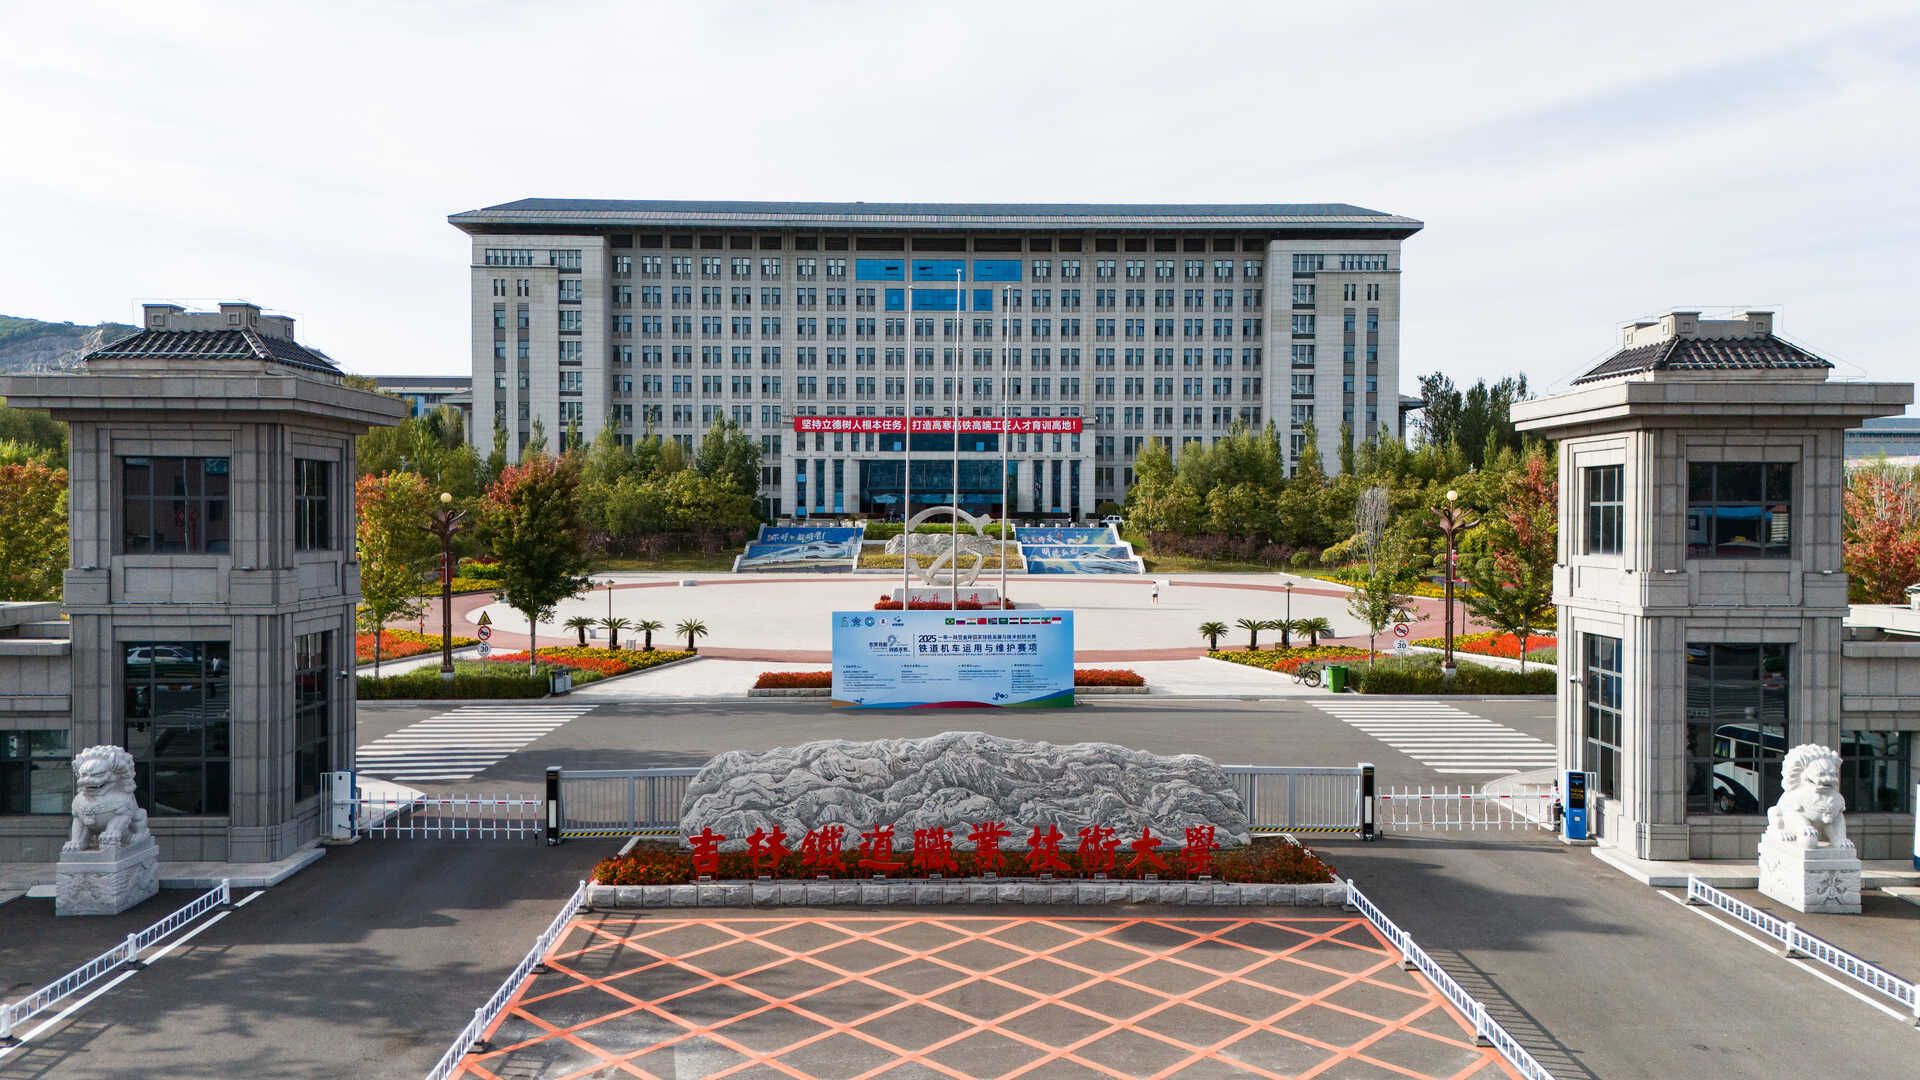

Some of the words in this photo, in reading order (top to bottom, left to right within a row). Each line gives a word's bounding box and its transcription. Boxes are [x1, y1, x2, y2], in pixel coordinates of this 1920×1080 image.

[918, 634, 937, 643] 2025
[918, 643, 1038, 653] 铁道机车运用与维护赛项
